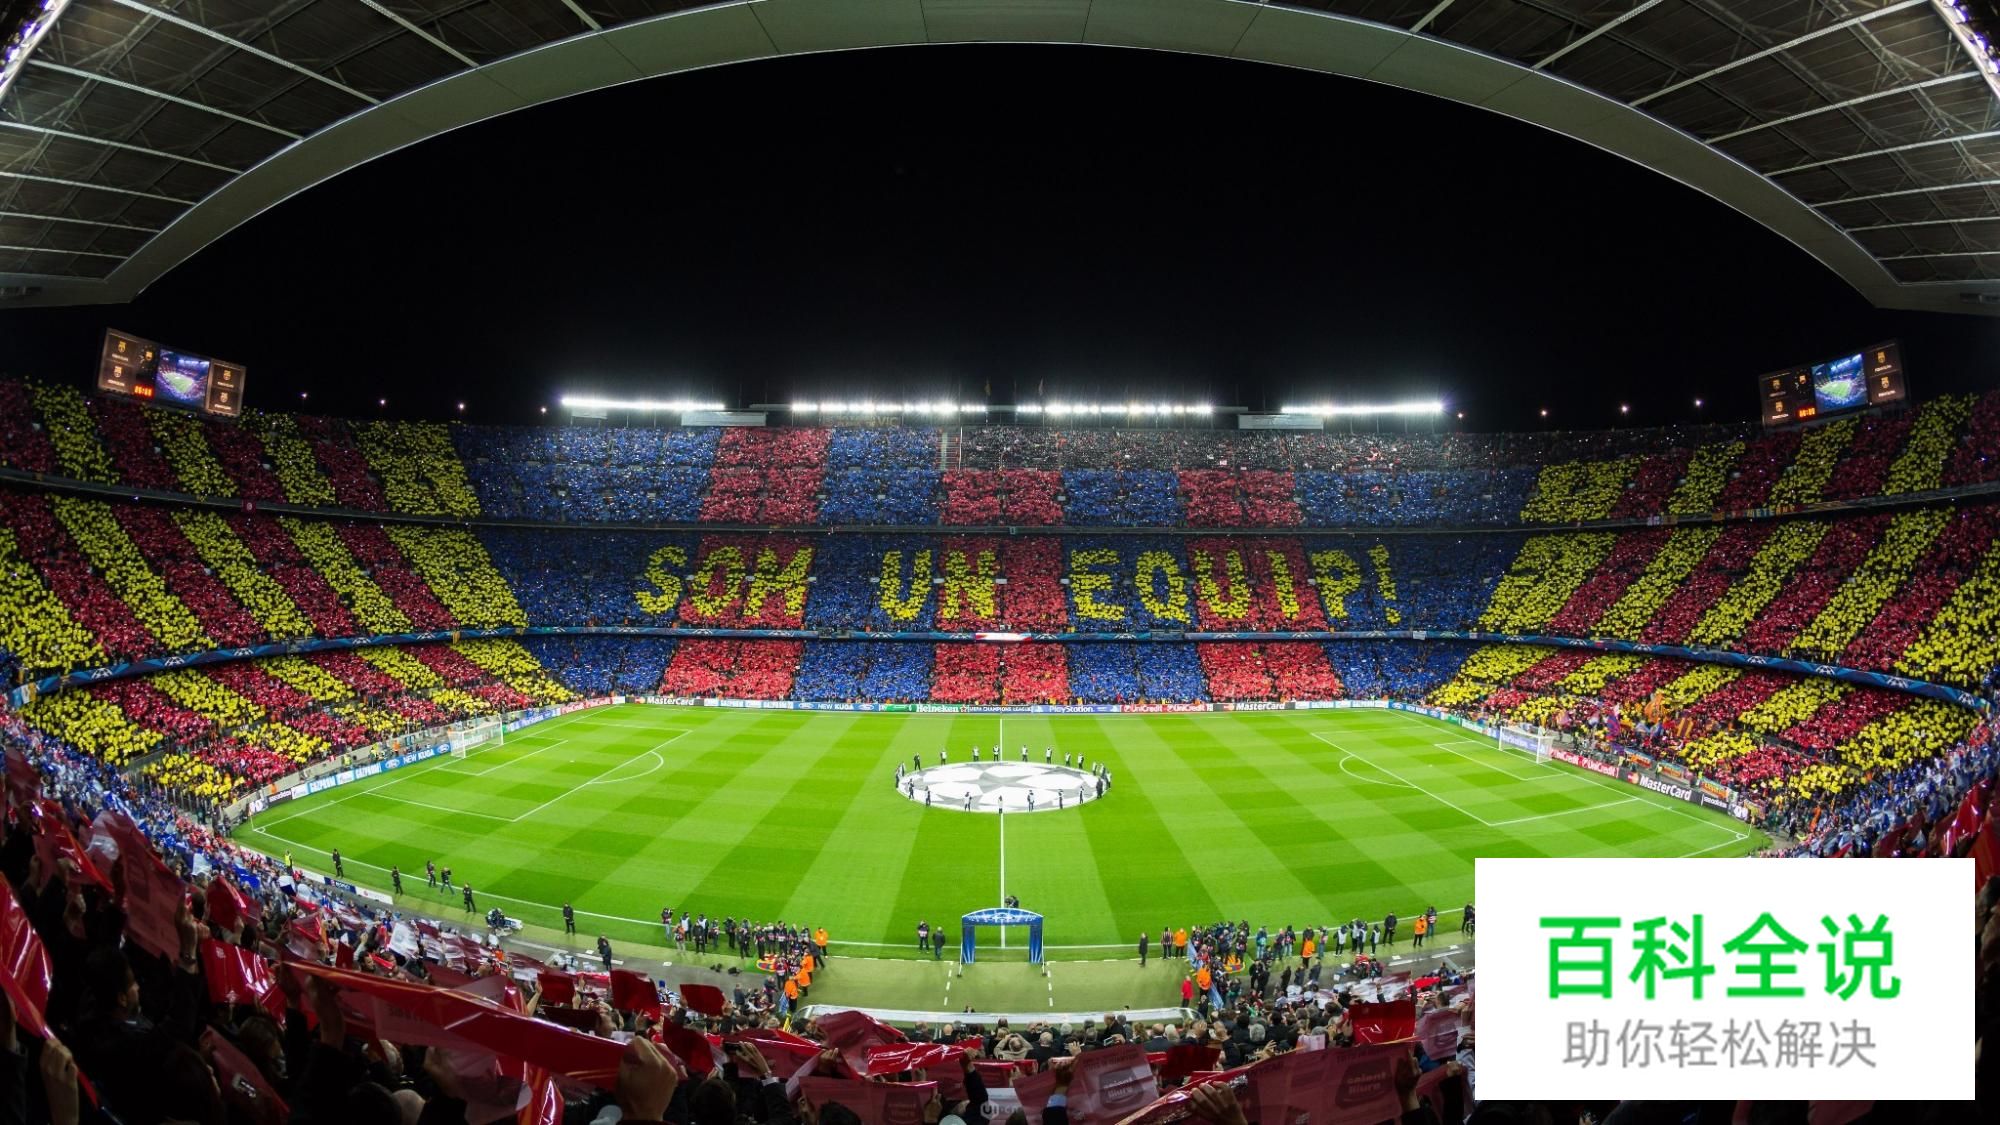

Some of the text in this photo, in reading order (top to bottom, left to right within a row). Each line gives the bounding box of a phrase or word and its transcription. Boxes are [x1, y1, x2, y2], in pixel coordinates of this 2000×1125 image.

[634, 545, 1401, 624] SOM UN EQUIP!
[646, 697, 694, 706] MasterCard
[916, 703, 959, 712] Heineken
[1049, 704, 1094, 714] PlayStation
[1236, 702, 1285, 711] MasterCard
[1639, 774, 1692, 801] MasterCard
